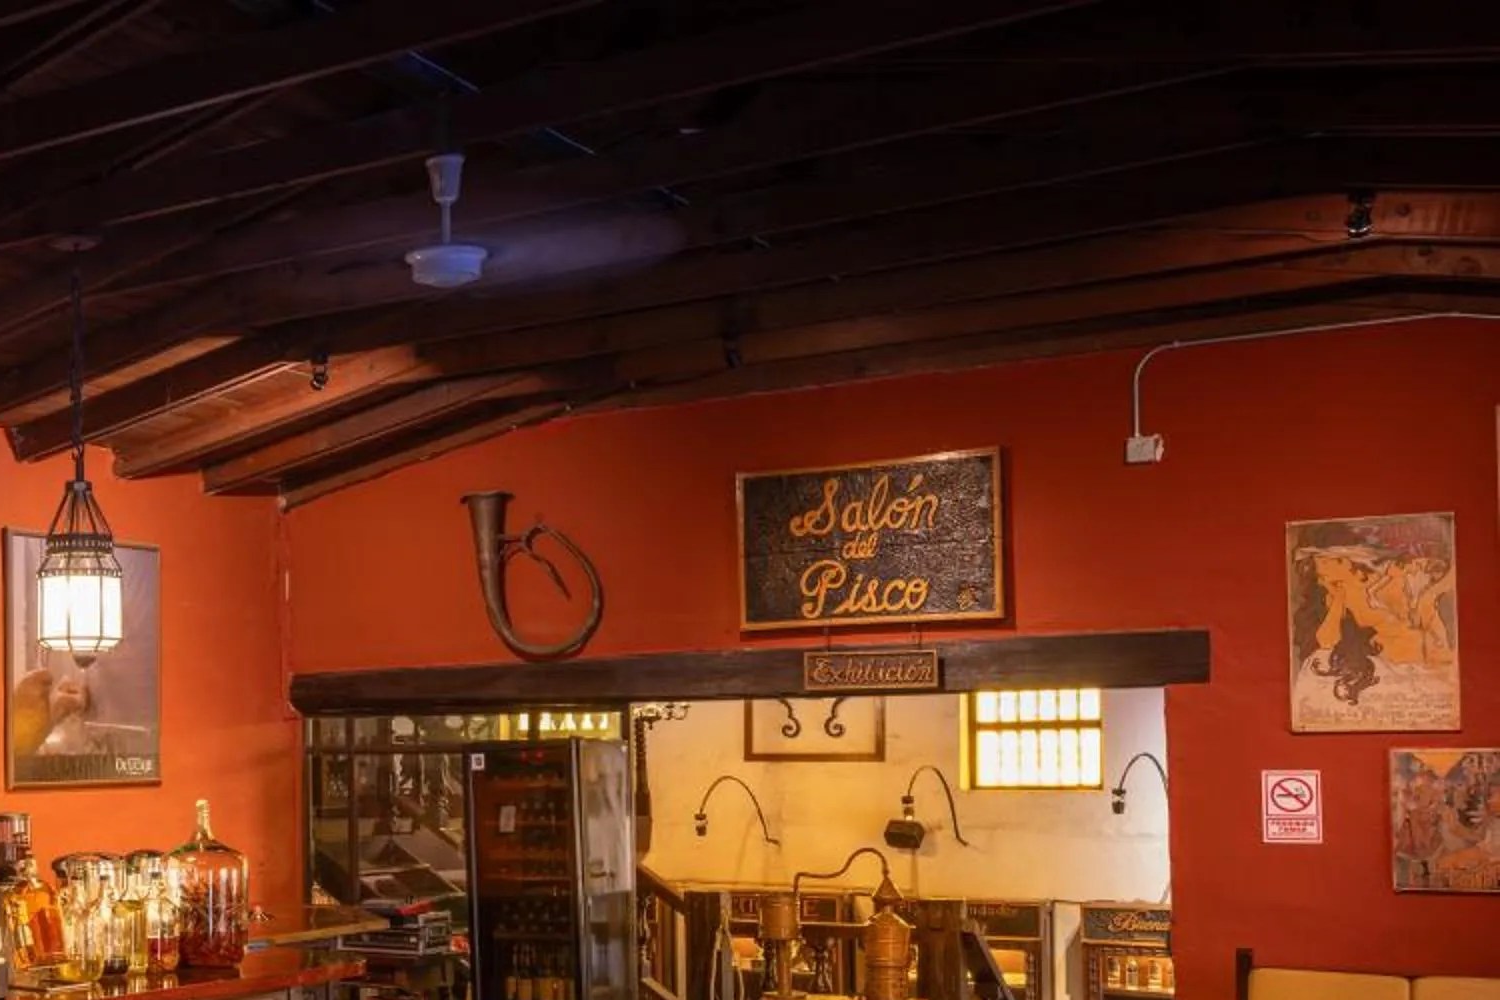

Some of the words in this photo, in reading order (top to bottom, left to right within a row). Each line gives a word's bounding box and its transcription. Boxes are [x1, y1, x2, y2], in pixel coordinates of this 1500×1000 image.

[790, 474, 939, 536] Salón
[843, 531, 878, 559] del
[801, 559, 930, 618] Pisco
